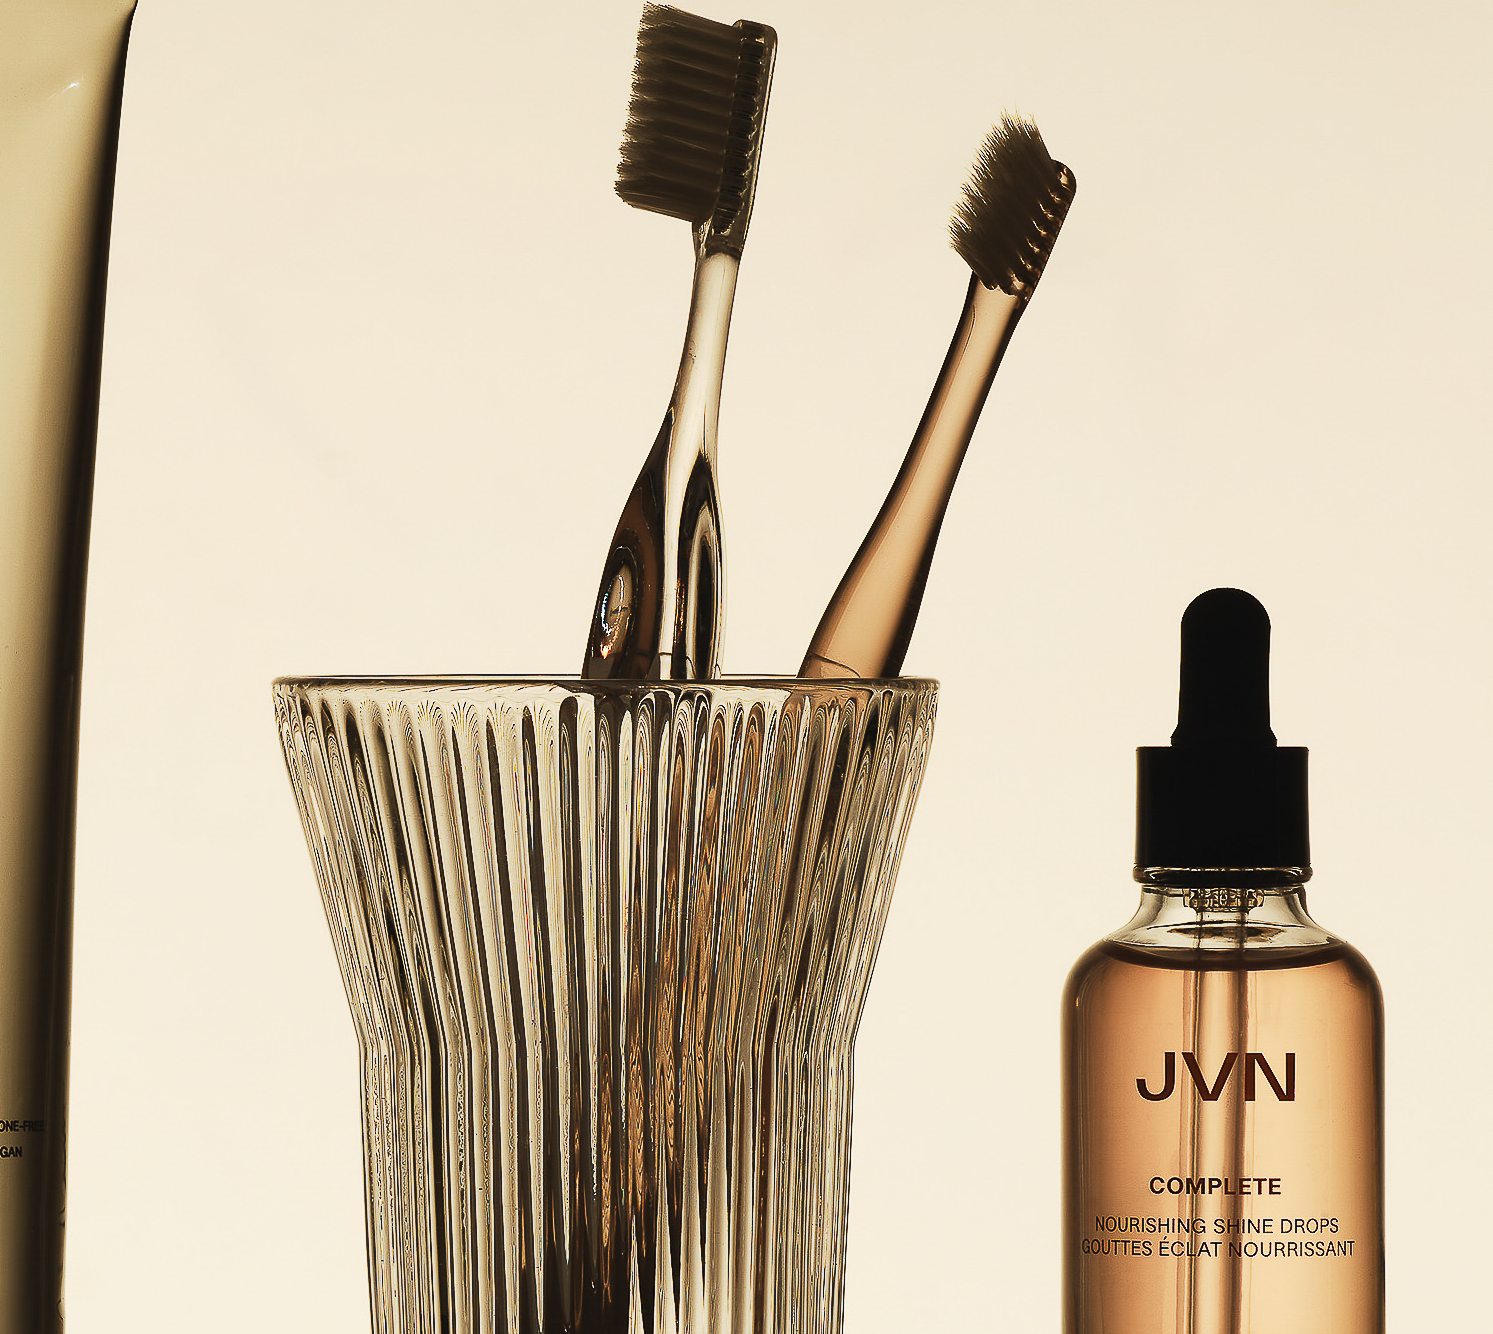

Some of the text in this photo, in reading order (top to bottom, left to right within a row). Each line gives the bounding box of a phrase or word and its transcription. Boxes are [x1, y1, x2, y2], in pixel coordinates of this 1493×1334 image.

[1135, 1051, 1296, 1102] JVN
[1149, 1176, 1282, 1196] COMPLETE
[1094, 1215, 1340, 1235] NOURISHING SHINE DROPS
[1081, 1235, 1356, 1258] GOUTTES ÉCLAT NOURRISSANT
